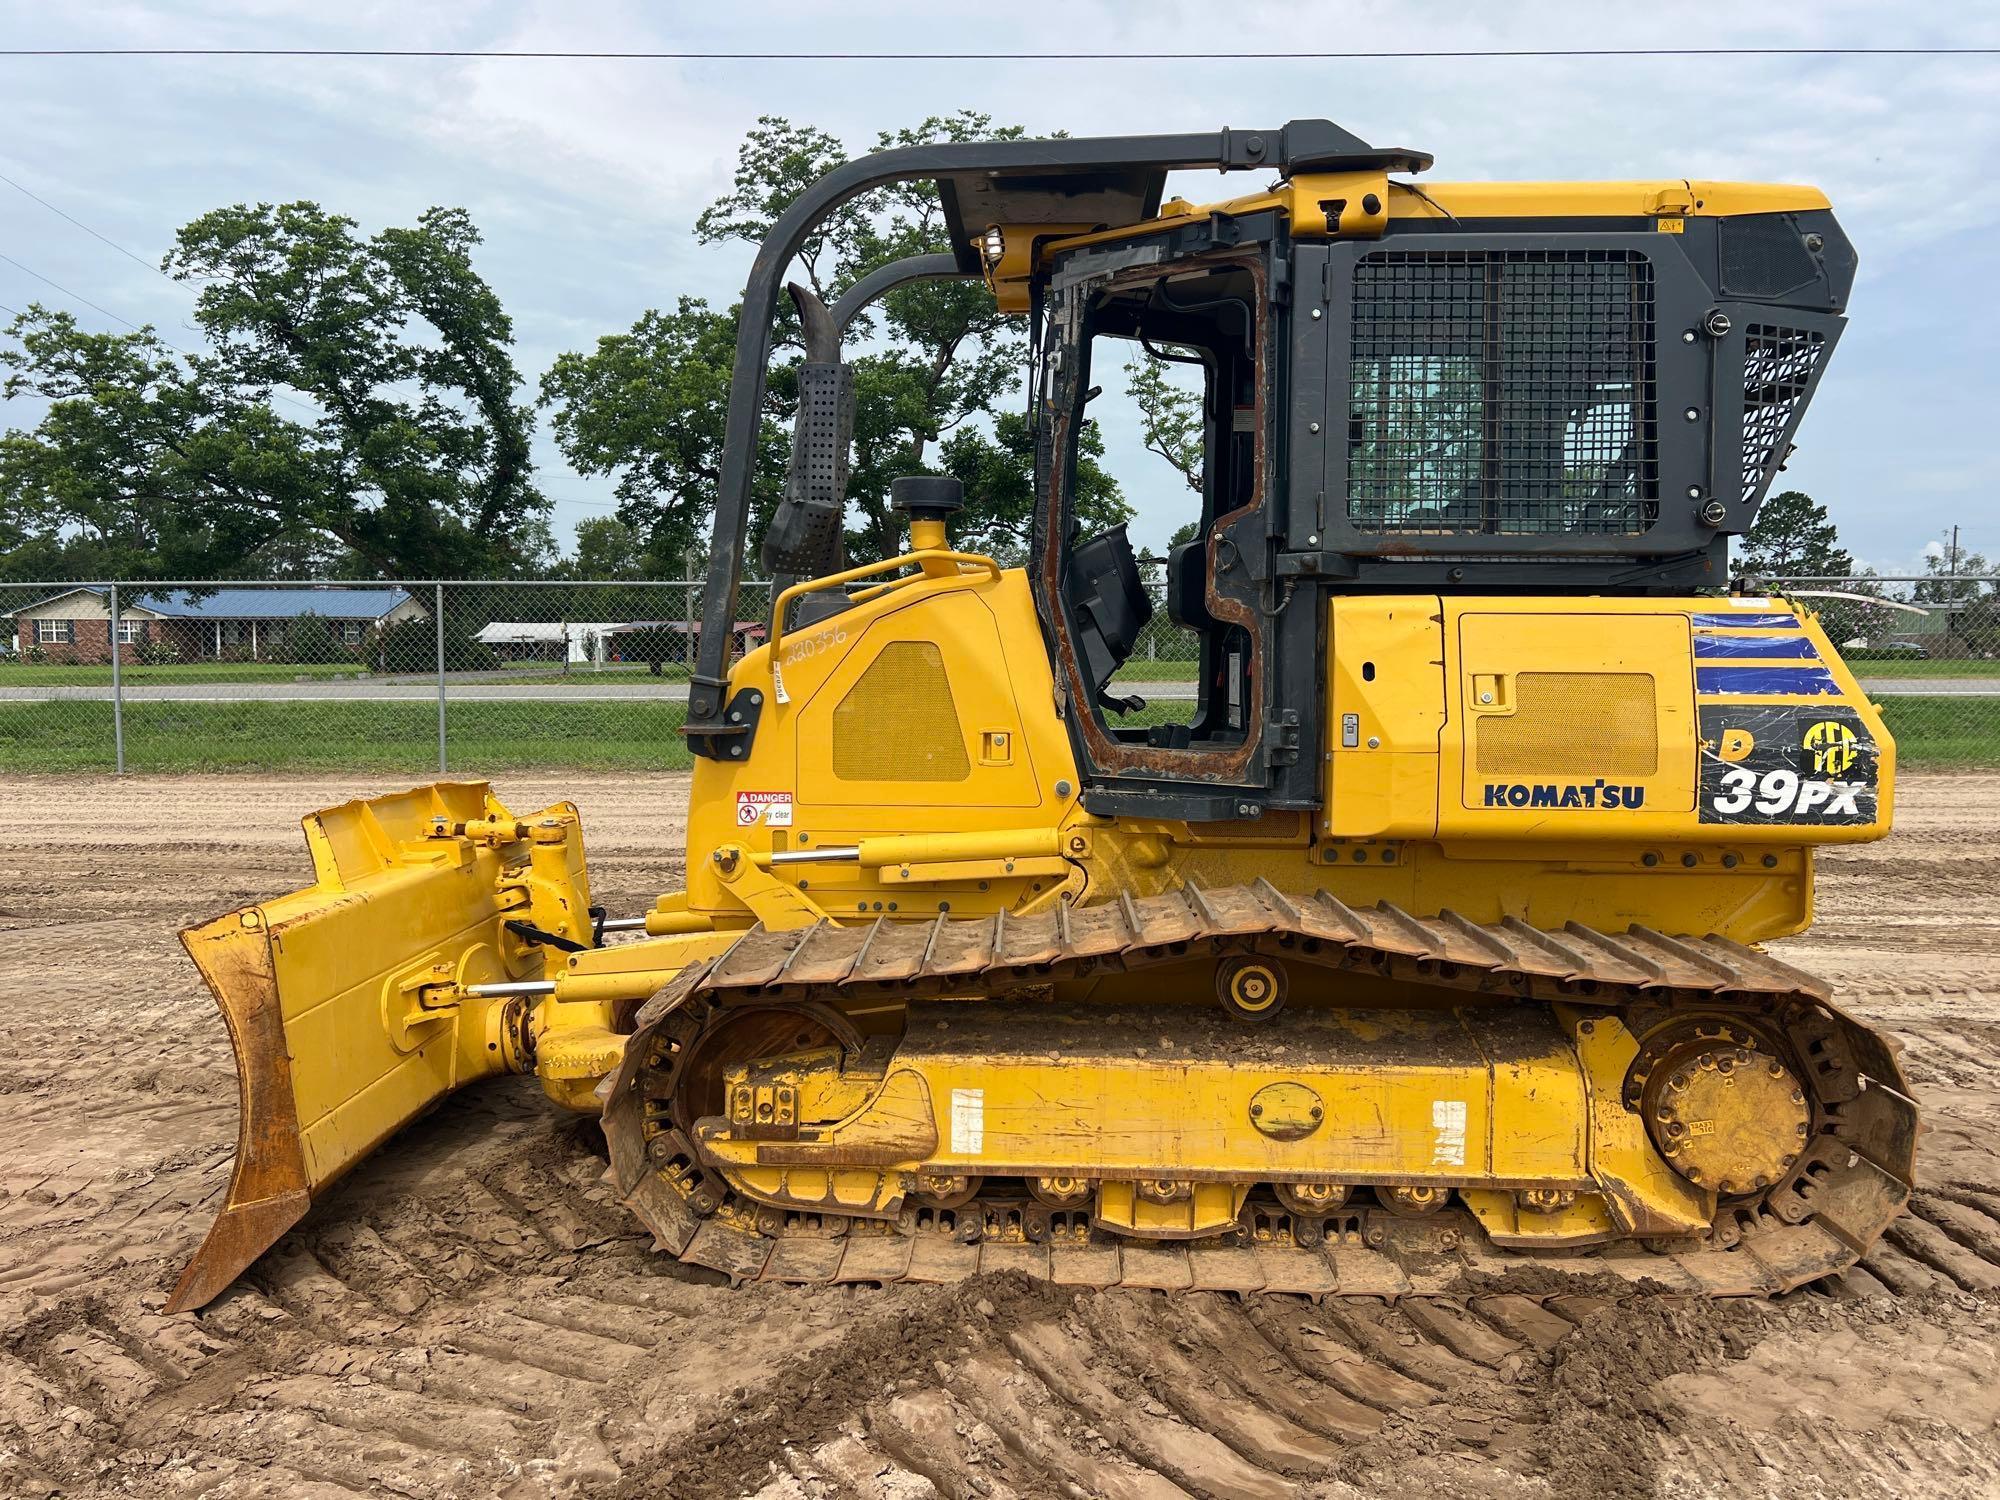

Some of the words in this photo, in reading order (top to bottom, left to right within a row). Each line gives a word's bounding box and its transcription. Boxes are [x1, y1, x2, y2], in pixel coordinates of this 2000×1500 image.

[1719, 729, 1754, 762] D
[750, 793, 792, 802] DANGER
[1484, 779, 1644, 809] KOMATSU
[1713, 769, 1867, 815] 39PX
[775, 810, 790, 819] clear
